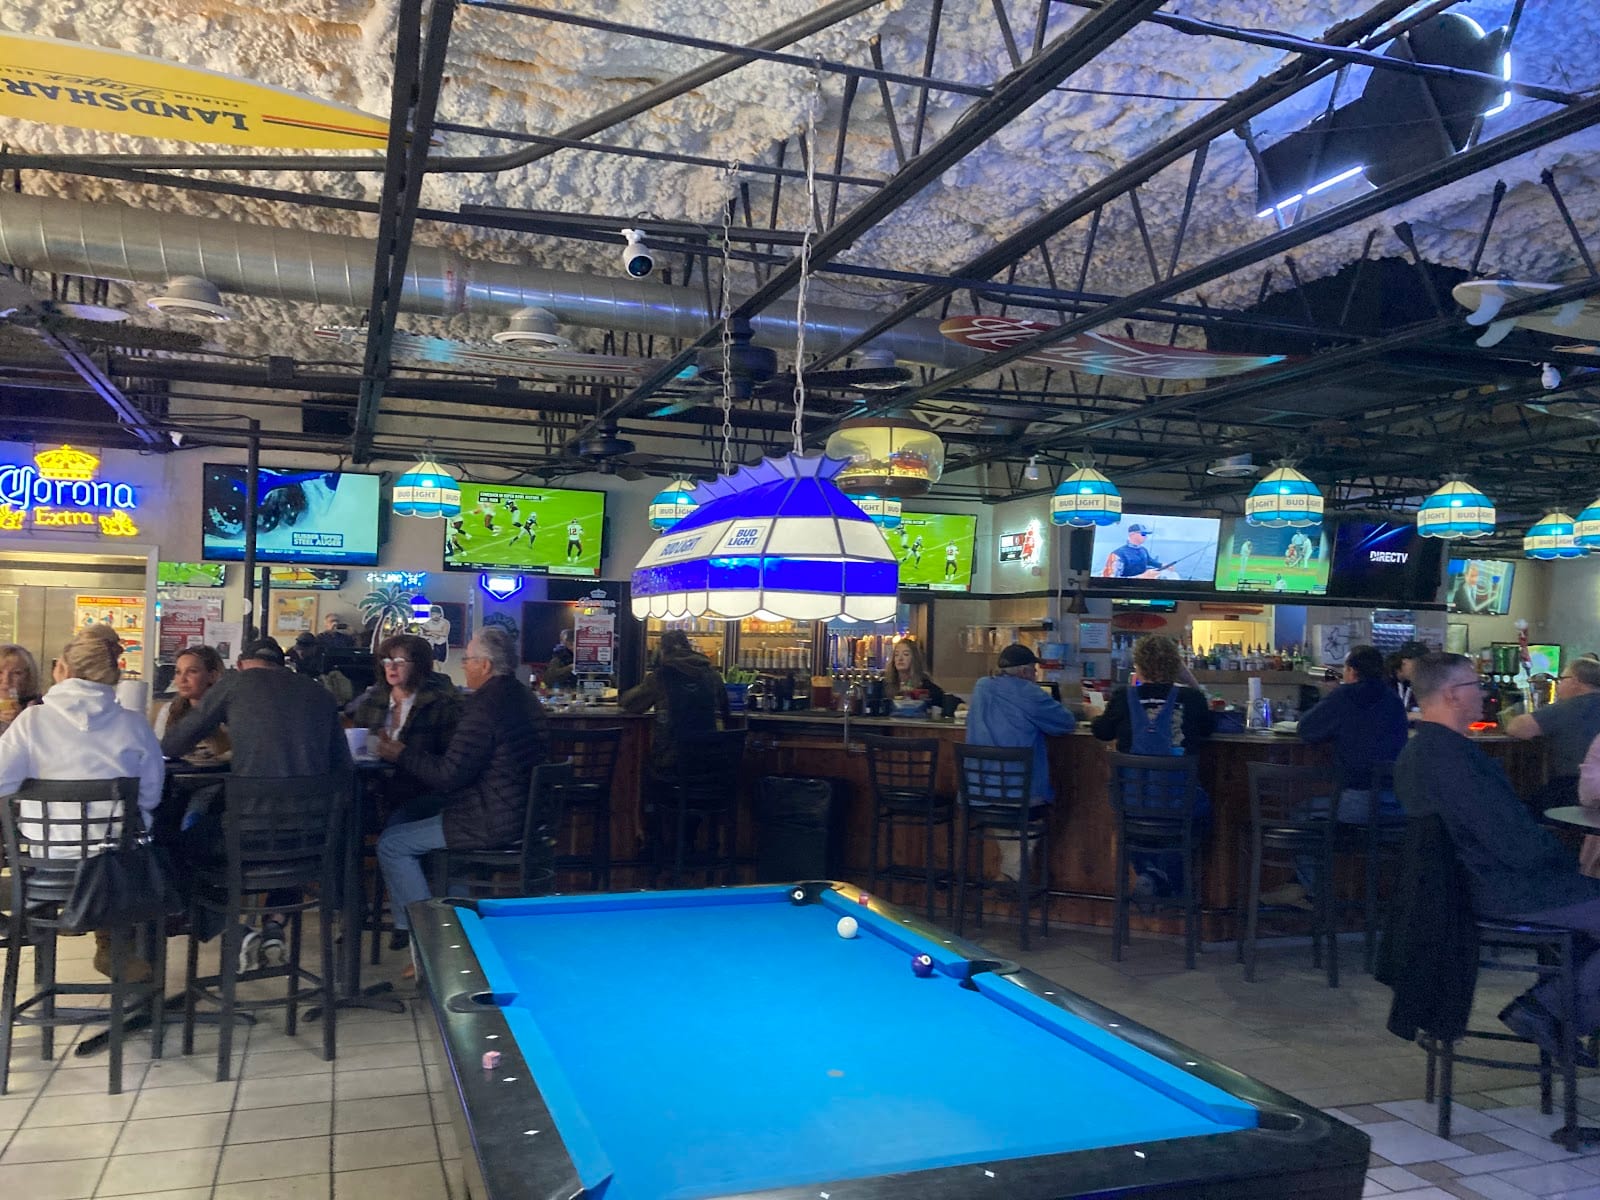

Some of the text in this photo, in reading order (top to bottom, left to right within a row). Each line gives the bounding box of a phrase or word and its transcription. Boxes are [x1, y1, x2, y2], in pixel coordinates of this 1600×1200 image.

[0, 78, 250, 131] LANDSHAR
[0, 464, 136, 510] Corona
[34, 506, 95, 526] Extra
[887, 505, 900, 513] BUD
[735, 528, 758, 538] BUD
[727, 537, 758, 546] LIGHT
[1369, 550, 1409, 564] DIRECTV
